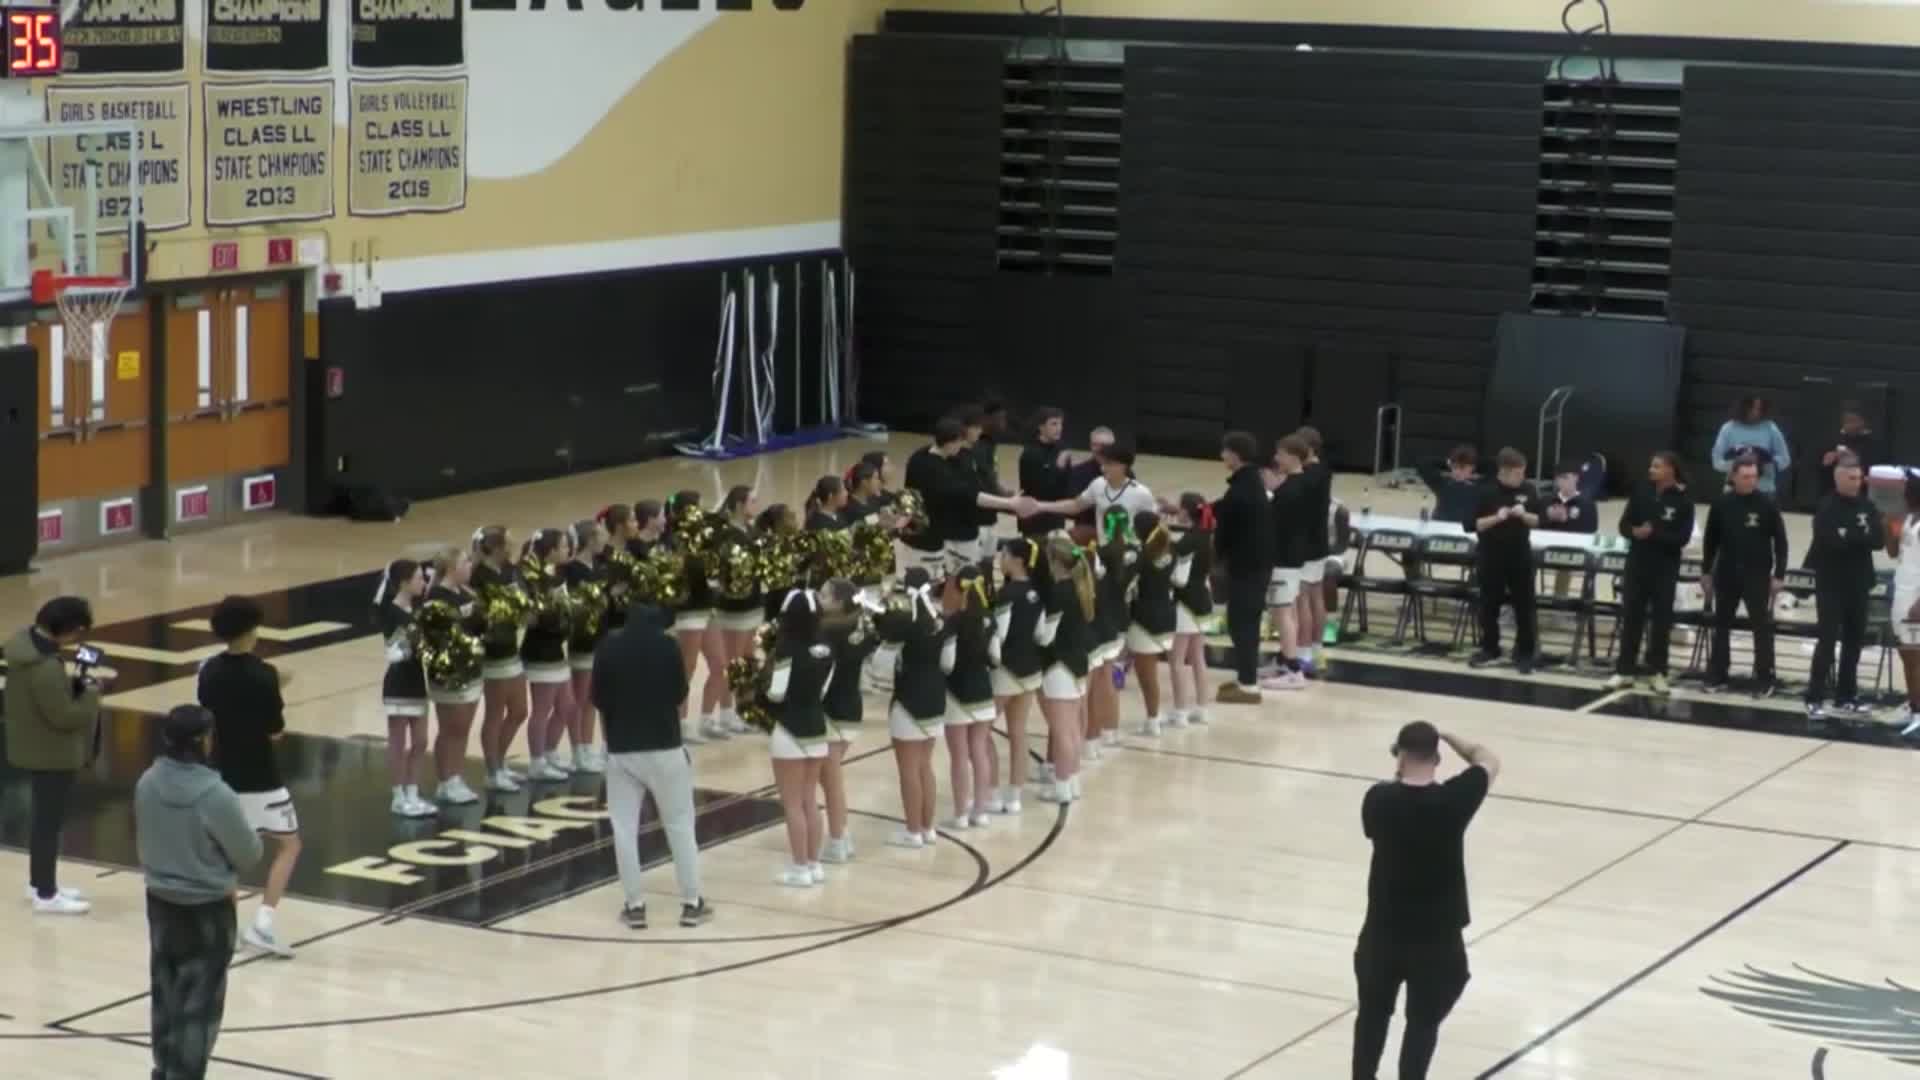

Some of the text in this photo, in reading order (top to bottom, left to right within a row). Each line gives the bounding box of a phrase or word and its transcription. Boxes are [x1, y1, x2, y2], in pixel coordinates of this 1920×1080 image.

[11, 14, 57, 69] 35
[61, 100, 176, 121] GIRLS BASKETBALL
[217, 96, 322, 117] WRESTLING
[359, 92, 456, 112] GIRLS VOLLEYBALL
[151, 130, 164, 150] L
[224, 124, 316, 147] CLASS LL
[366, 120, 451, 140] CLASS LL
[215, 151, 326, 181] STATE CHAMPIONS
[359, 145, 460, 174] STATE CHAMPIONS
[246, 186, 296, 208] 2013
[323, 796, 610, 885] FCIAC
